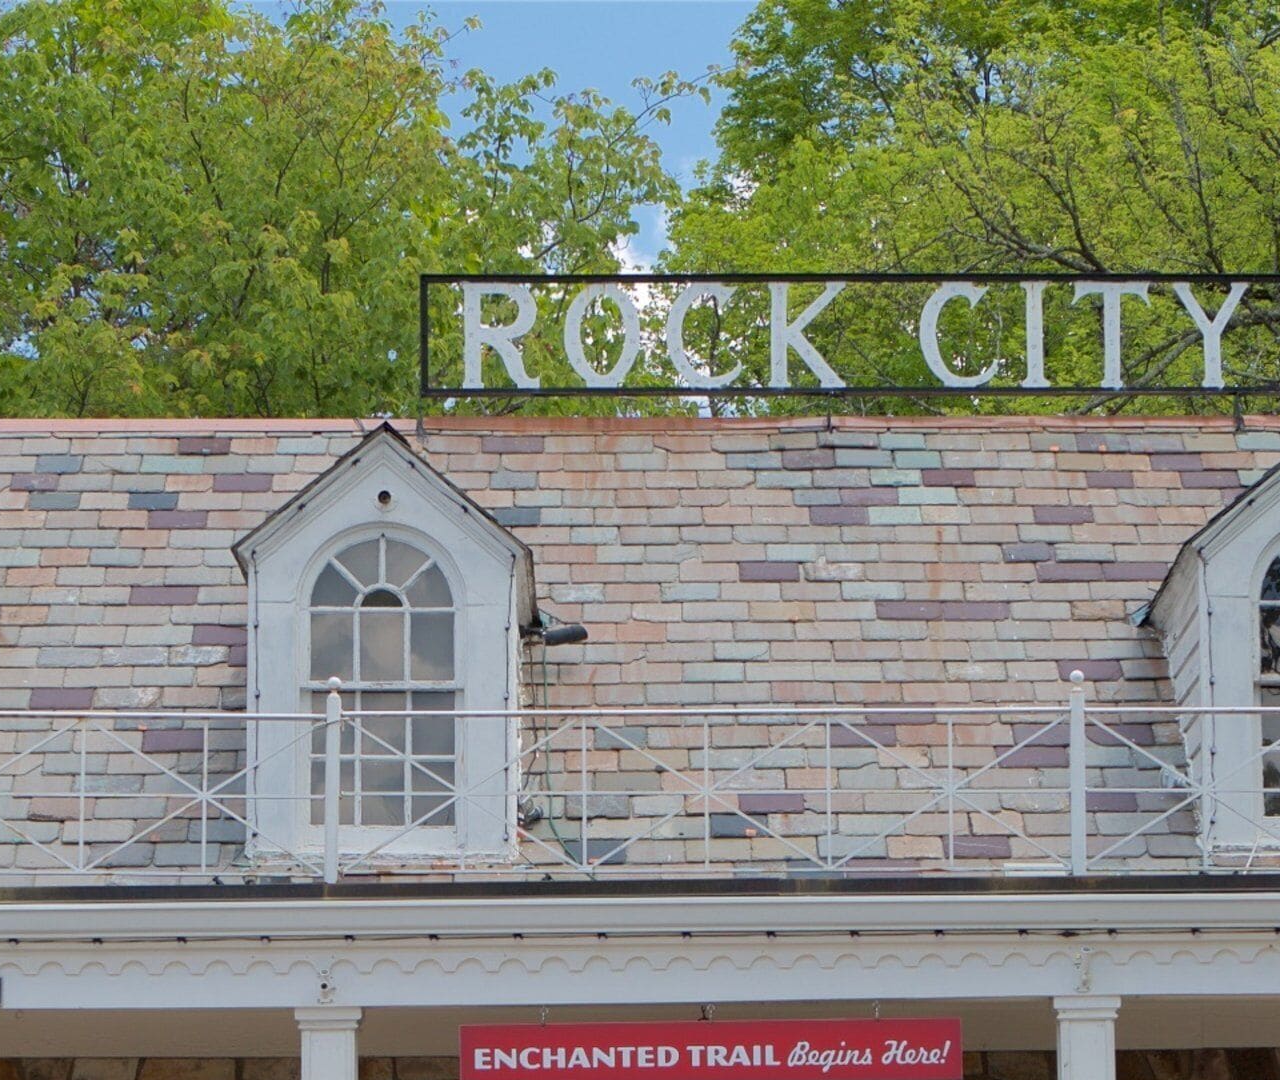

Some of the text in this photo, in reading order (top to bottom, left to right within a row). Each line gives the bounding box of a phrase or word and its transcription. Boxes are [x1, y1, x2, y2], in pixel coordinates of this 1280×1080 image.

[462, 281, 847, 390] ROCK
[920, 281, 1250, 390] CITY
[474, 1040, 950, 1073] ENCHANTED TRAIL Begins Here!
